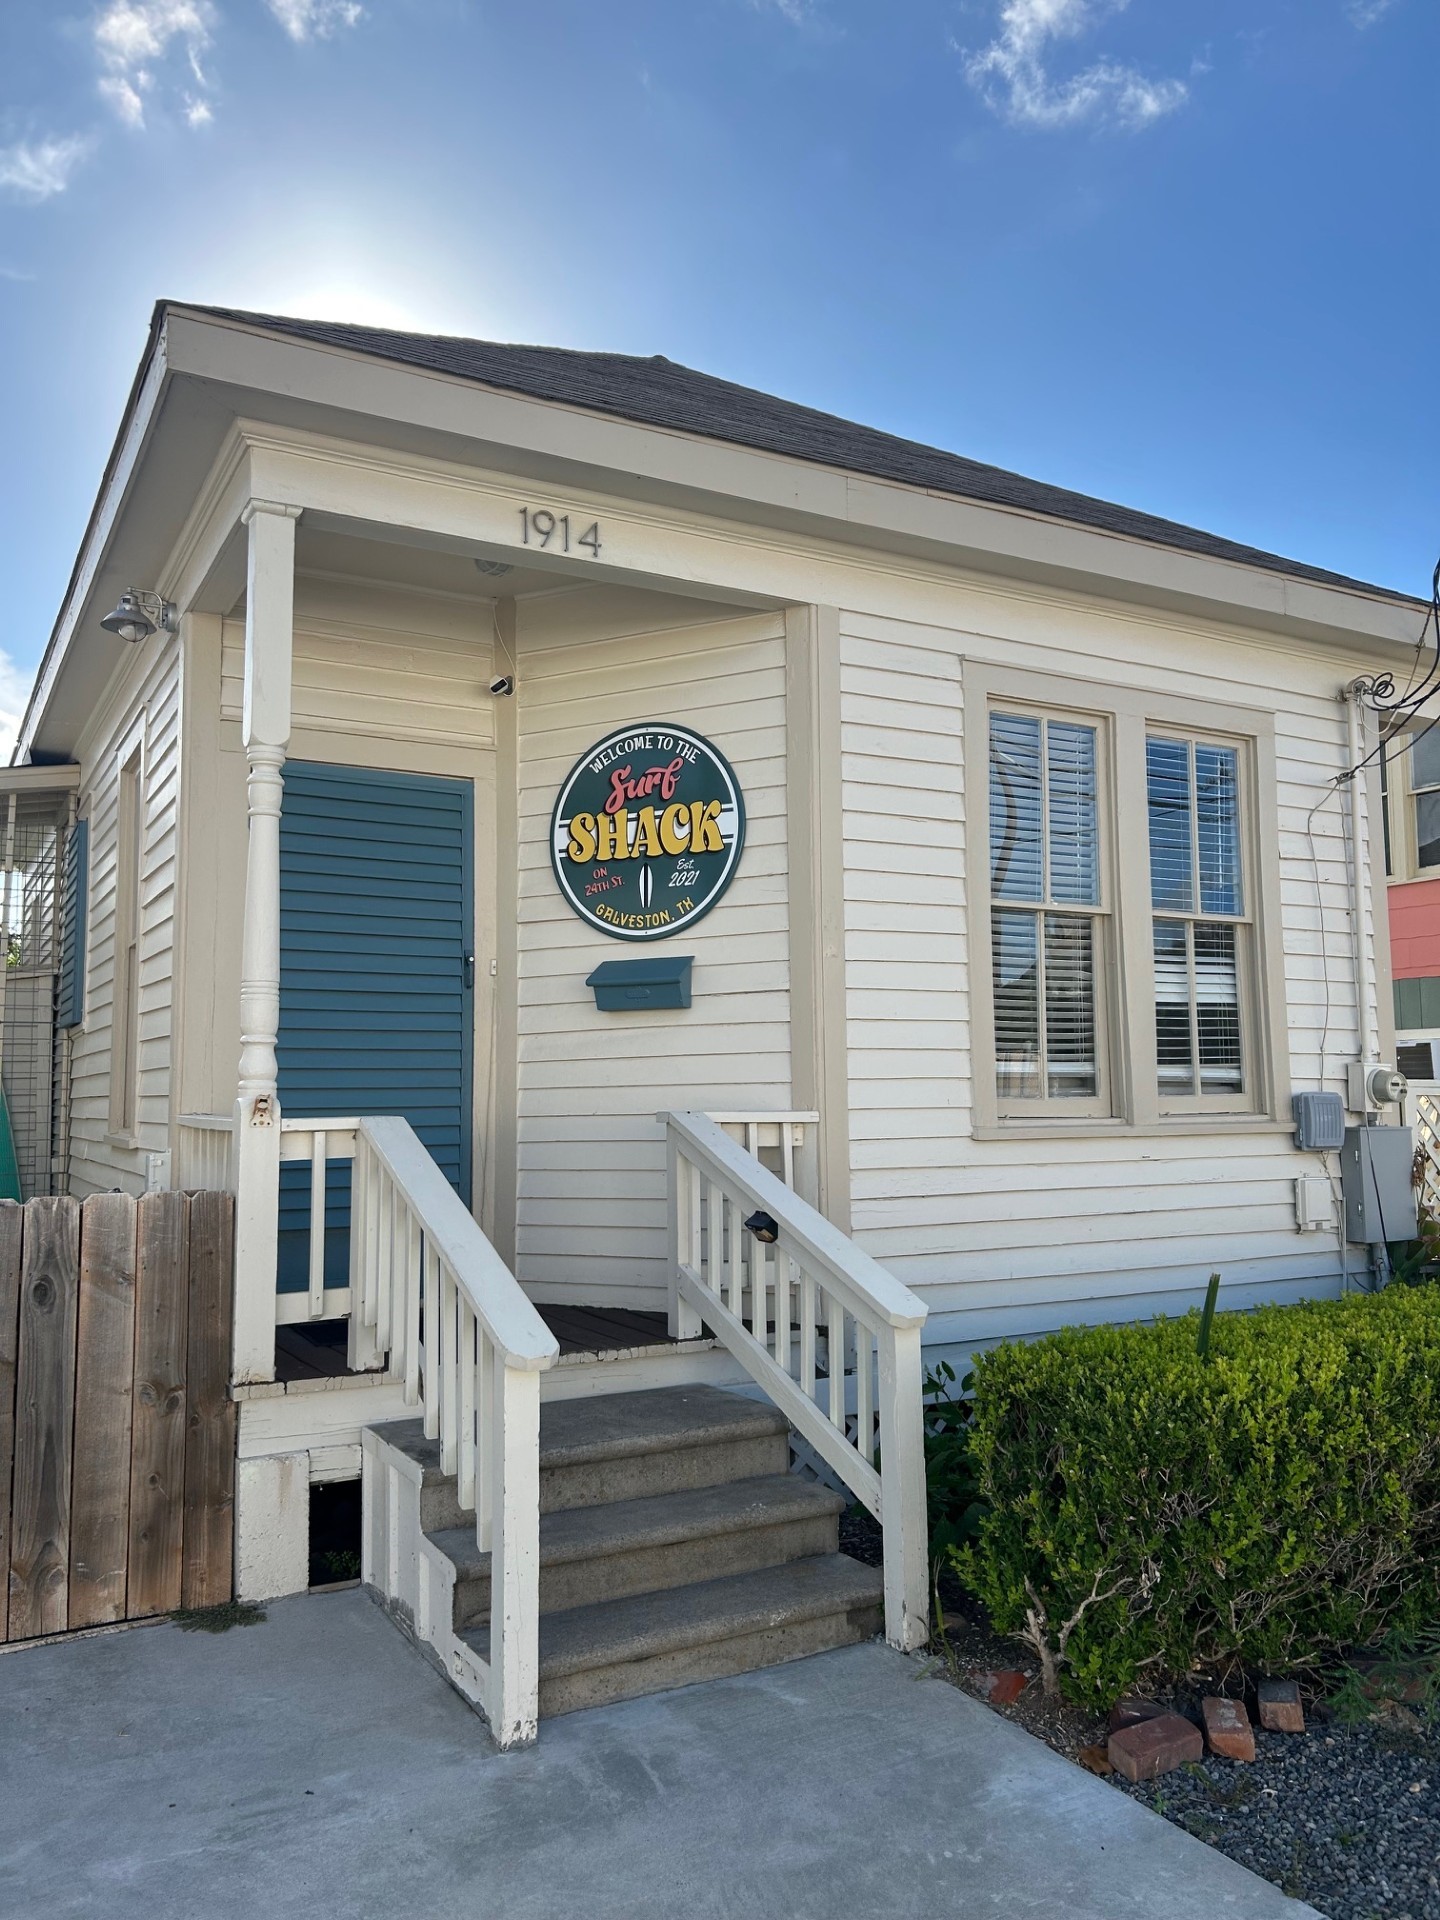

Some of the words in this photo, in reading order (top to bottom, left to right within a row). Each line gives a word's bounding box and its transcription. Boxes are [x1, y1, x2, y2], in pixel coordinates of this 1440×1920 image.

[519, 506, 602, 558] 1914
[588, 735, 653, 774] WELCOME
[657, 735, 673, 751] TO
[676, 740, 701, 764] THE
[605, 757, 683, 814] Surf
[568, 799, 725, 863] SHACK
[592, 867, 608, 879] ON
[677, 858, 694, 870] Est.
[584, 881, 609, 896] 24TH
[668, 870, 700, 888] 2021
[595, 903, 675, 929] GALVESTON,
